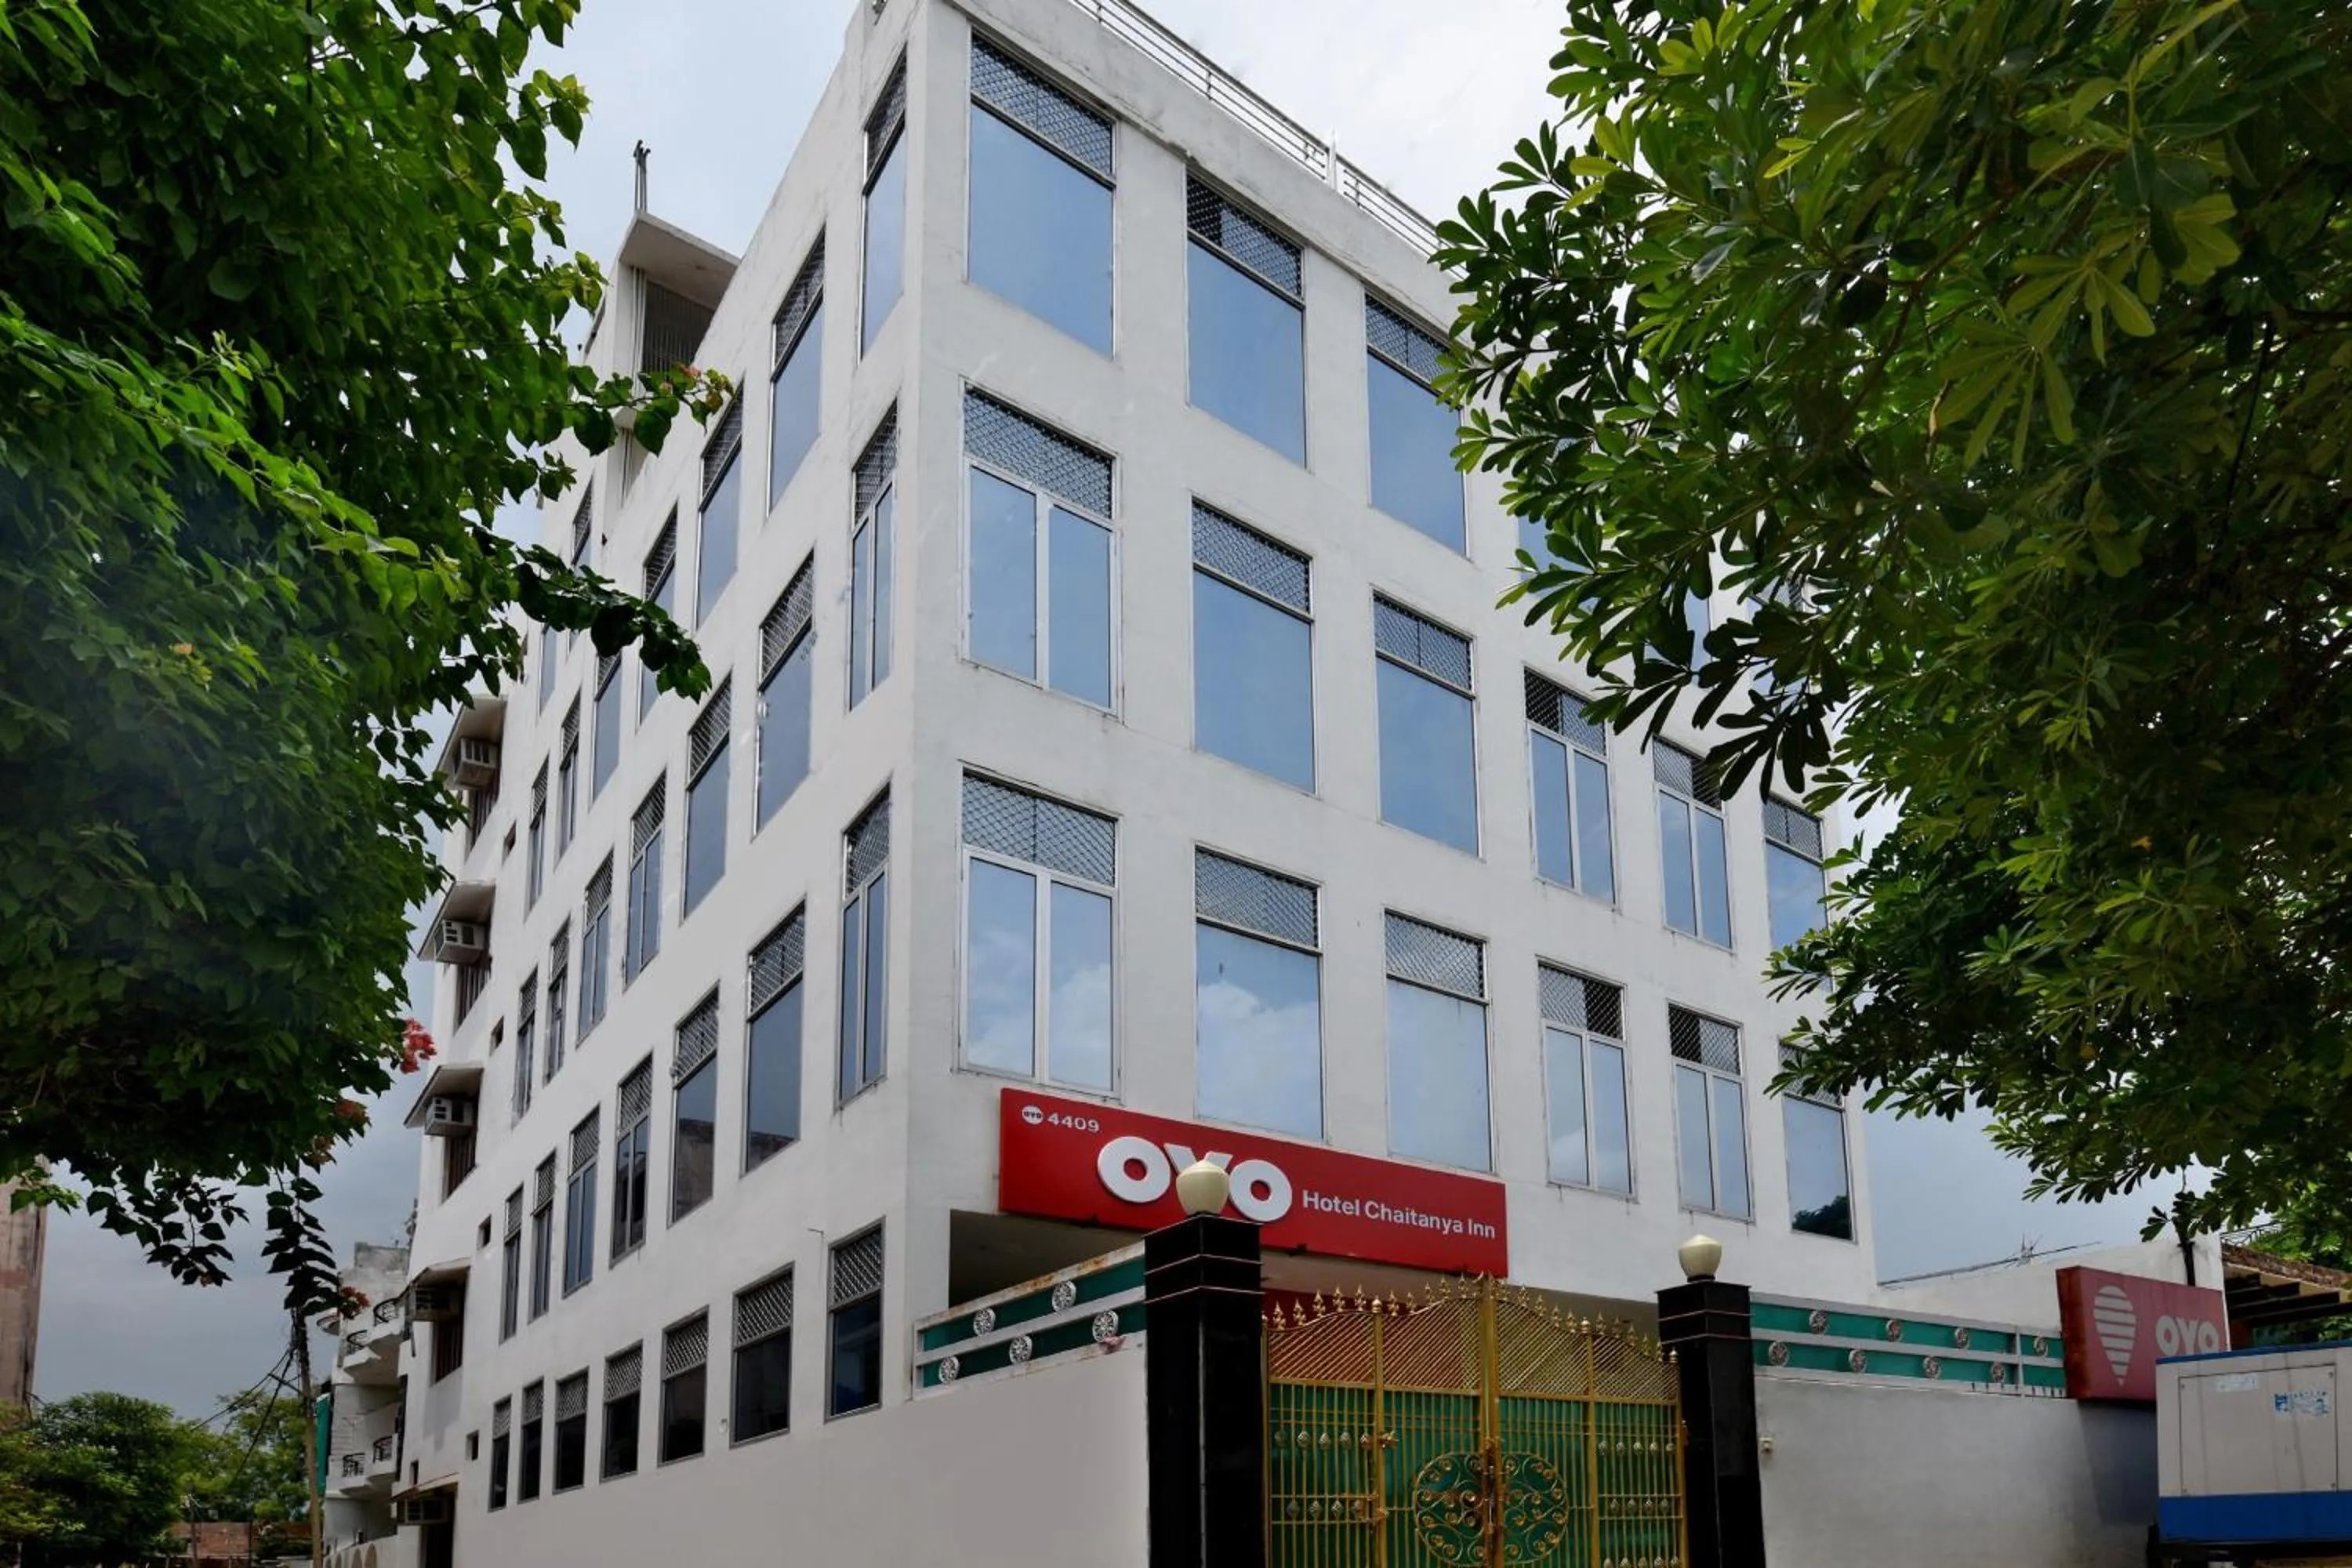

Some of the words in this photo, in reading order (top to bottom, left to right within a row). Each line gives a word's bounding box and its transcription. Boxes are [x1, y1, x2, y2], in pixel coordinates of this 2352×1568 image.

[1047, 1112, 1099, 1133] 4409
[1302, 1189, 1360, 1217] Hotel
[1365, 1201, 1464, 1235] Chaitanya
[1468, 1218, 1496, 1240] Inn
[2155, 1315, 2219, 1356] OYO
